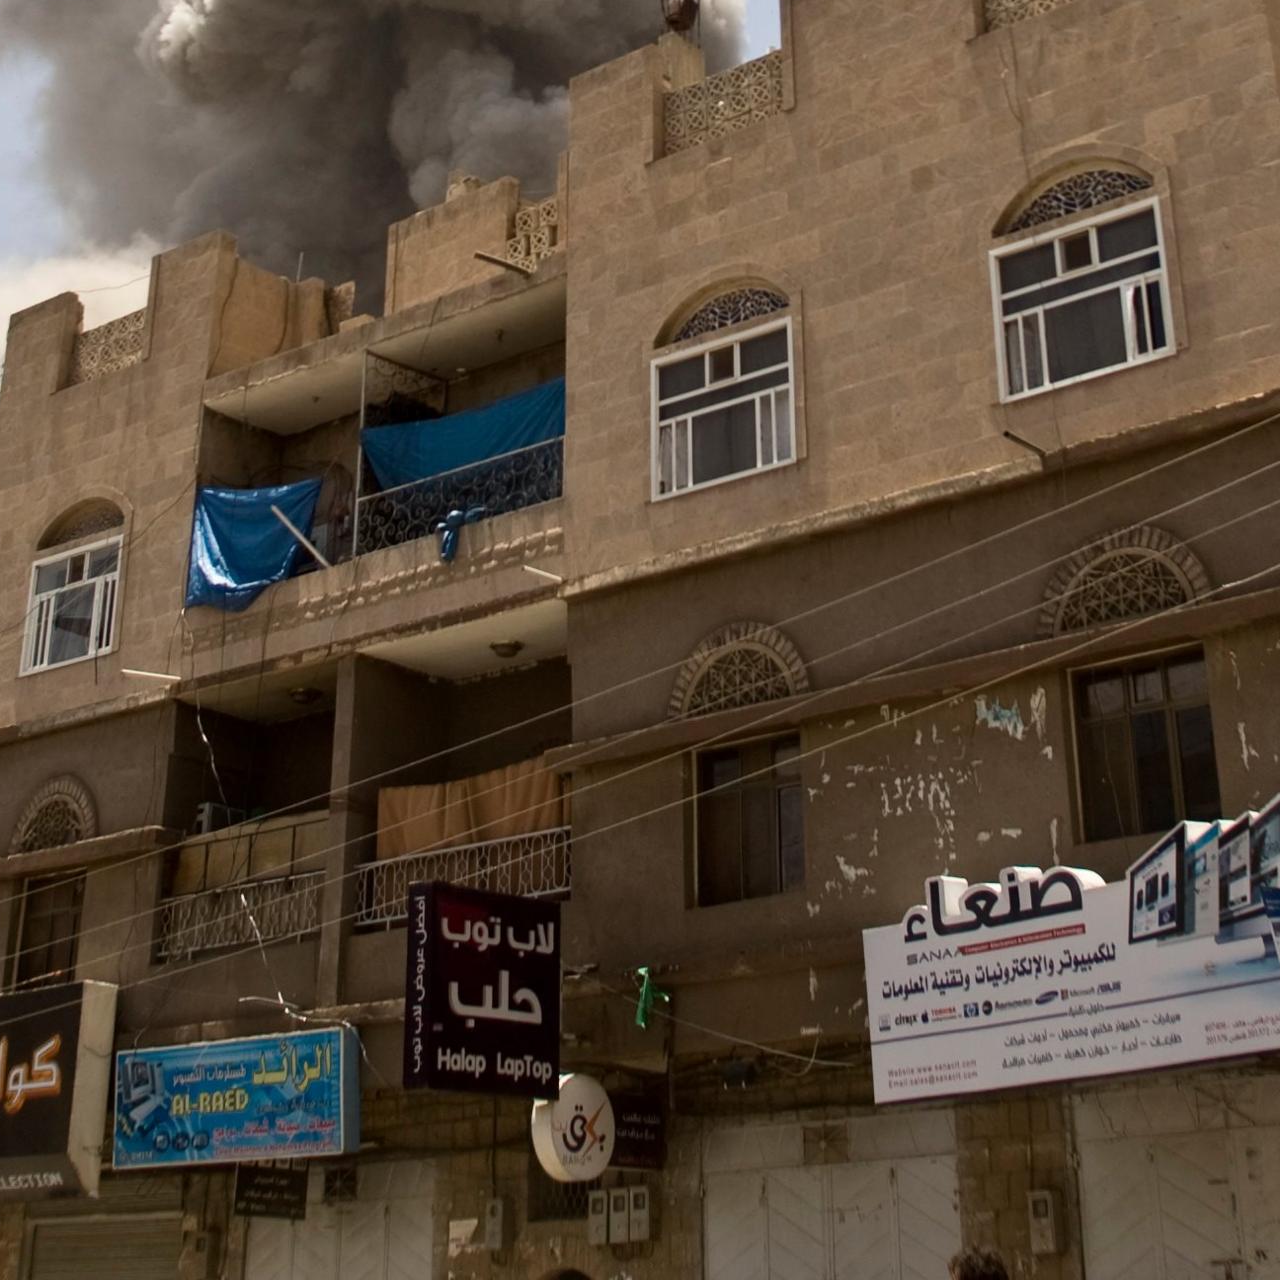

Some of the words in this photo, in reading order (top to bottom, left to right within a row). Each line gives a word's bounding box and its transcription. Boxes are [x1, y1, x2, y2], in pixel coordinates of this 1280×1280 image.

[904, 871, 1083, 943] صنعاء
[441, 916, 502, 952] توب
[507, 921, 555, 958] لاب
[414, 950, 426, 1002] عروض
[1058, 942, 1117, 975] للكمبيوتر
[448, 969, 543, 1029] حلب
[882, 977, 929, 1001] المعلومات
[931, 968, 971, 996] وتقنية
[252, 1040, 333, 1093] الرائد
[437, 1047, 487, 1079] Halap
[496, 1051, 553, 1085] LapTop
